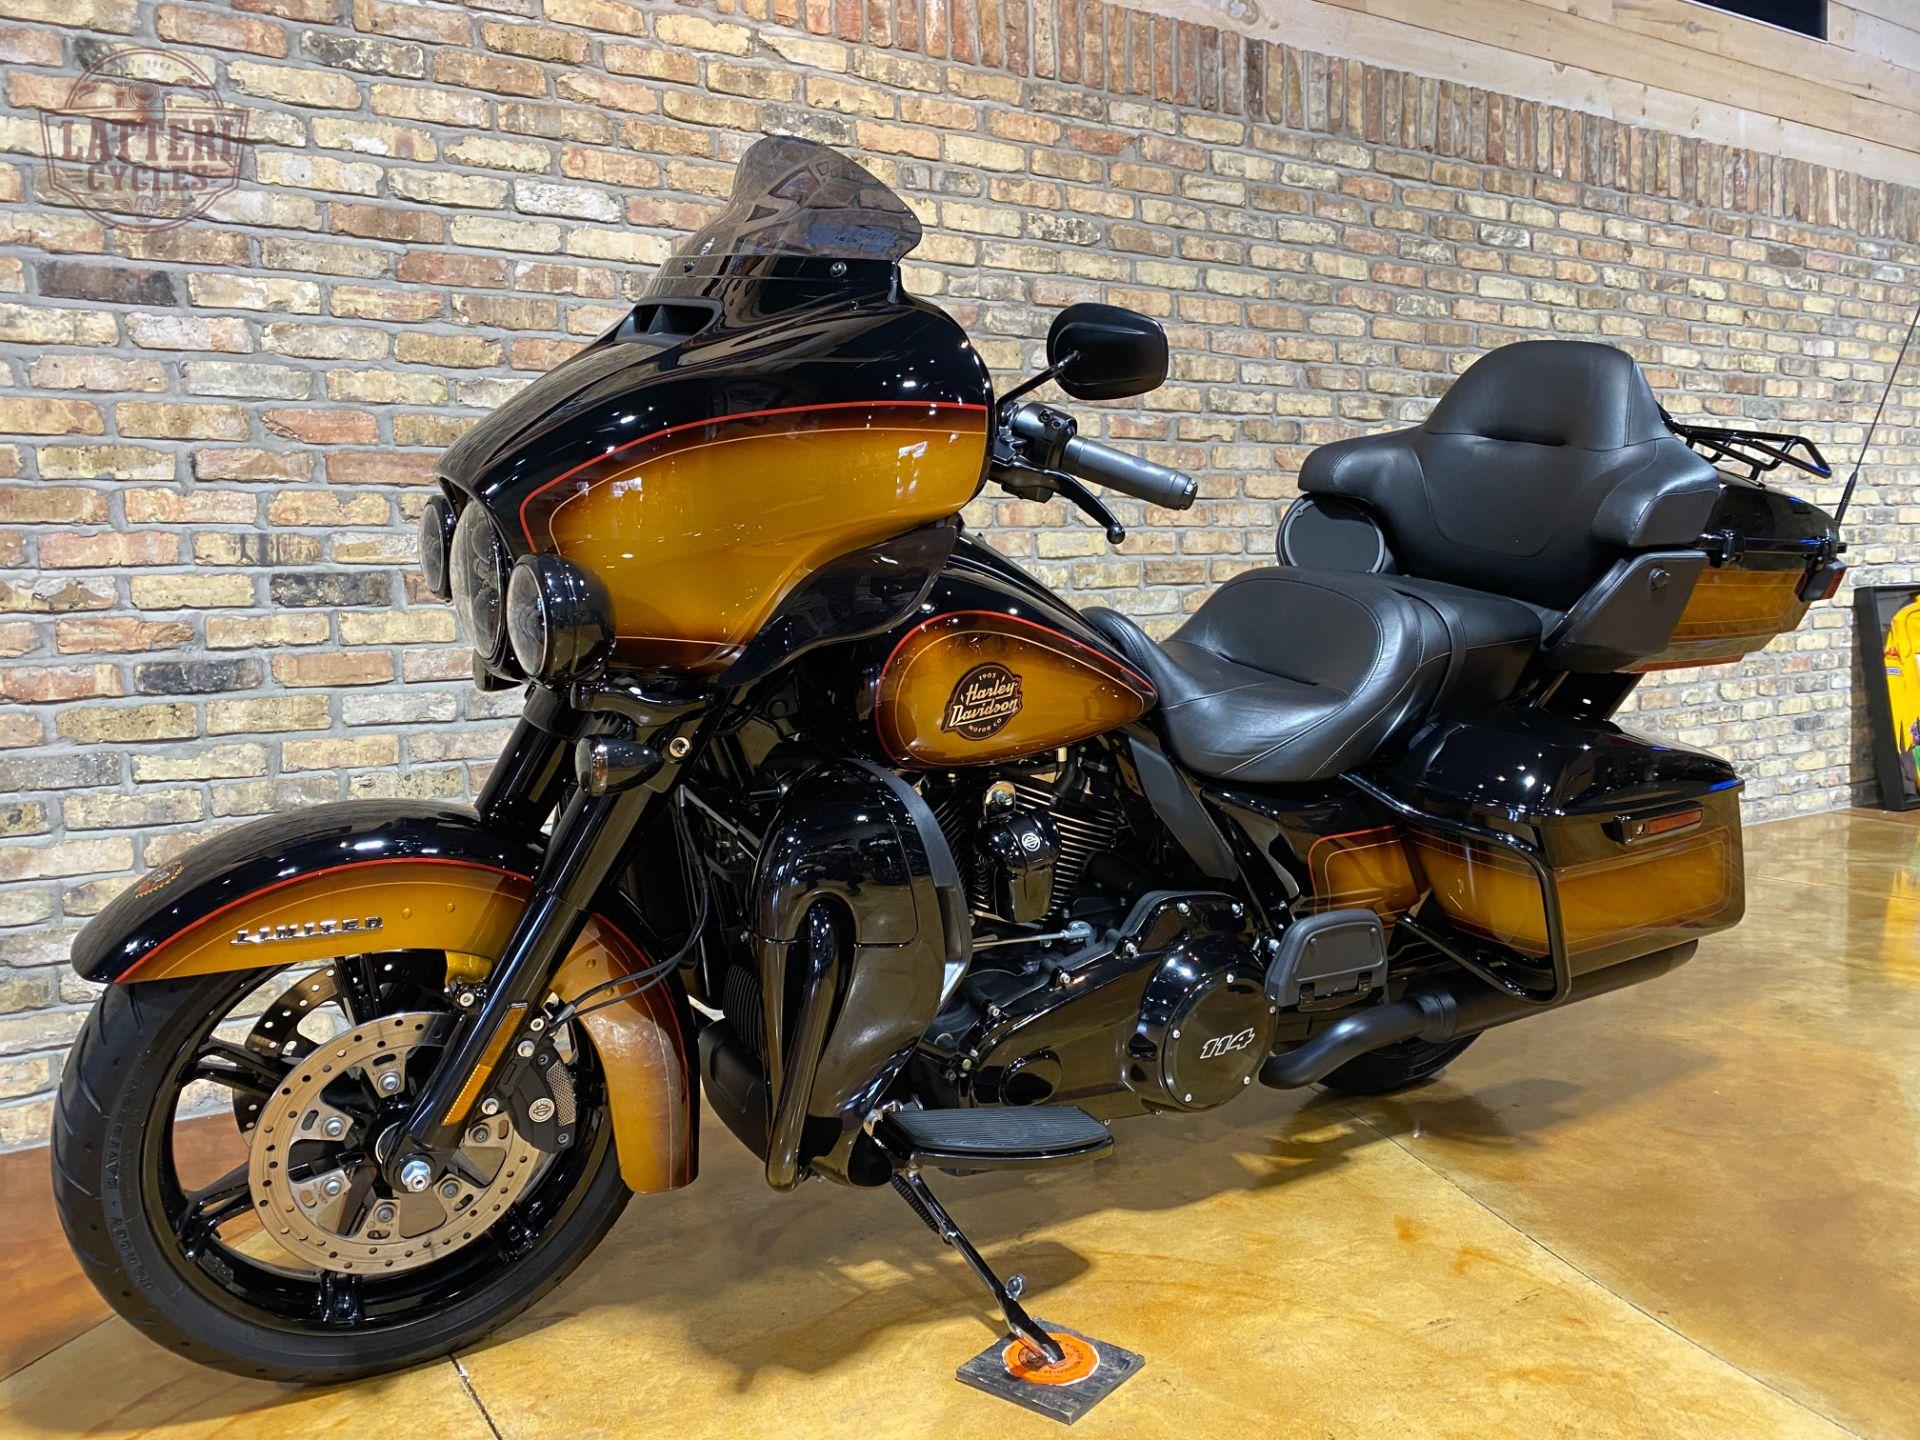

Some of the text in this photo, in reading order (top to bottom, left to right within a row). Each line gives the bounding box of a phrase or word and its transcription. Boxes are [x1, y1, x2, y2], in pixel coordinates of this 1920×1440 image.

[949, 697, 1019, 727] Davidson
[230, 916, 384, 945] LIMITED
[1199, 1027, 1256, 1060] 114
